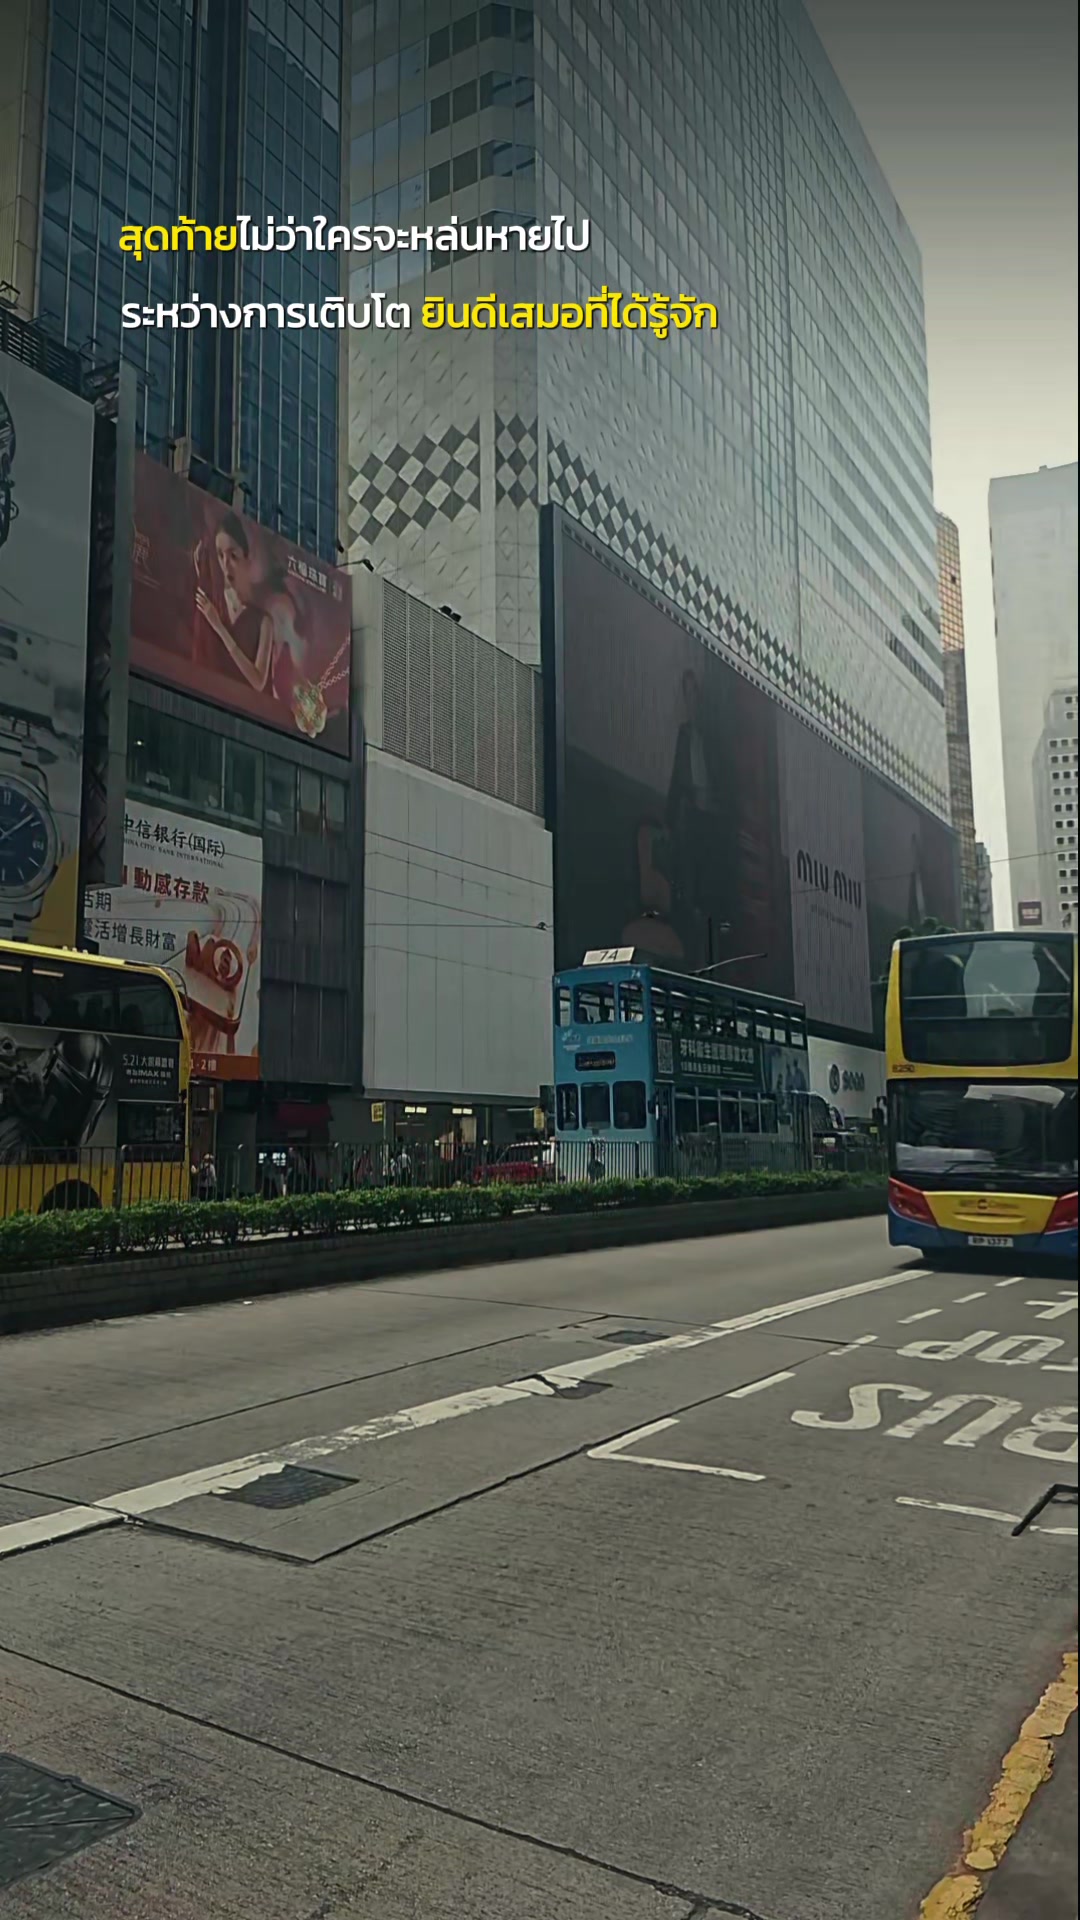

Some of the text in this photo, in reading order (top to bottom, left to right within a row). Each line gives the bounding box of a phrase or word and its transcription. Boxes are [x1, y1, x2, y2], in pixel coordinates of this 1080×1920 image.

[123, 865, 209, 904] 動感存款
[600, 949, 619, 962] 74
[630, 970, 641, 979] 74
